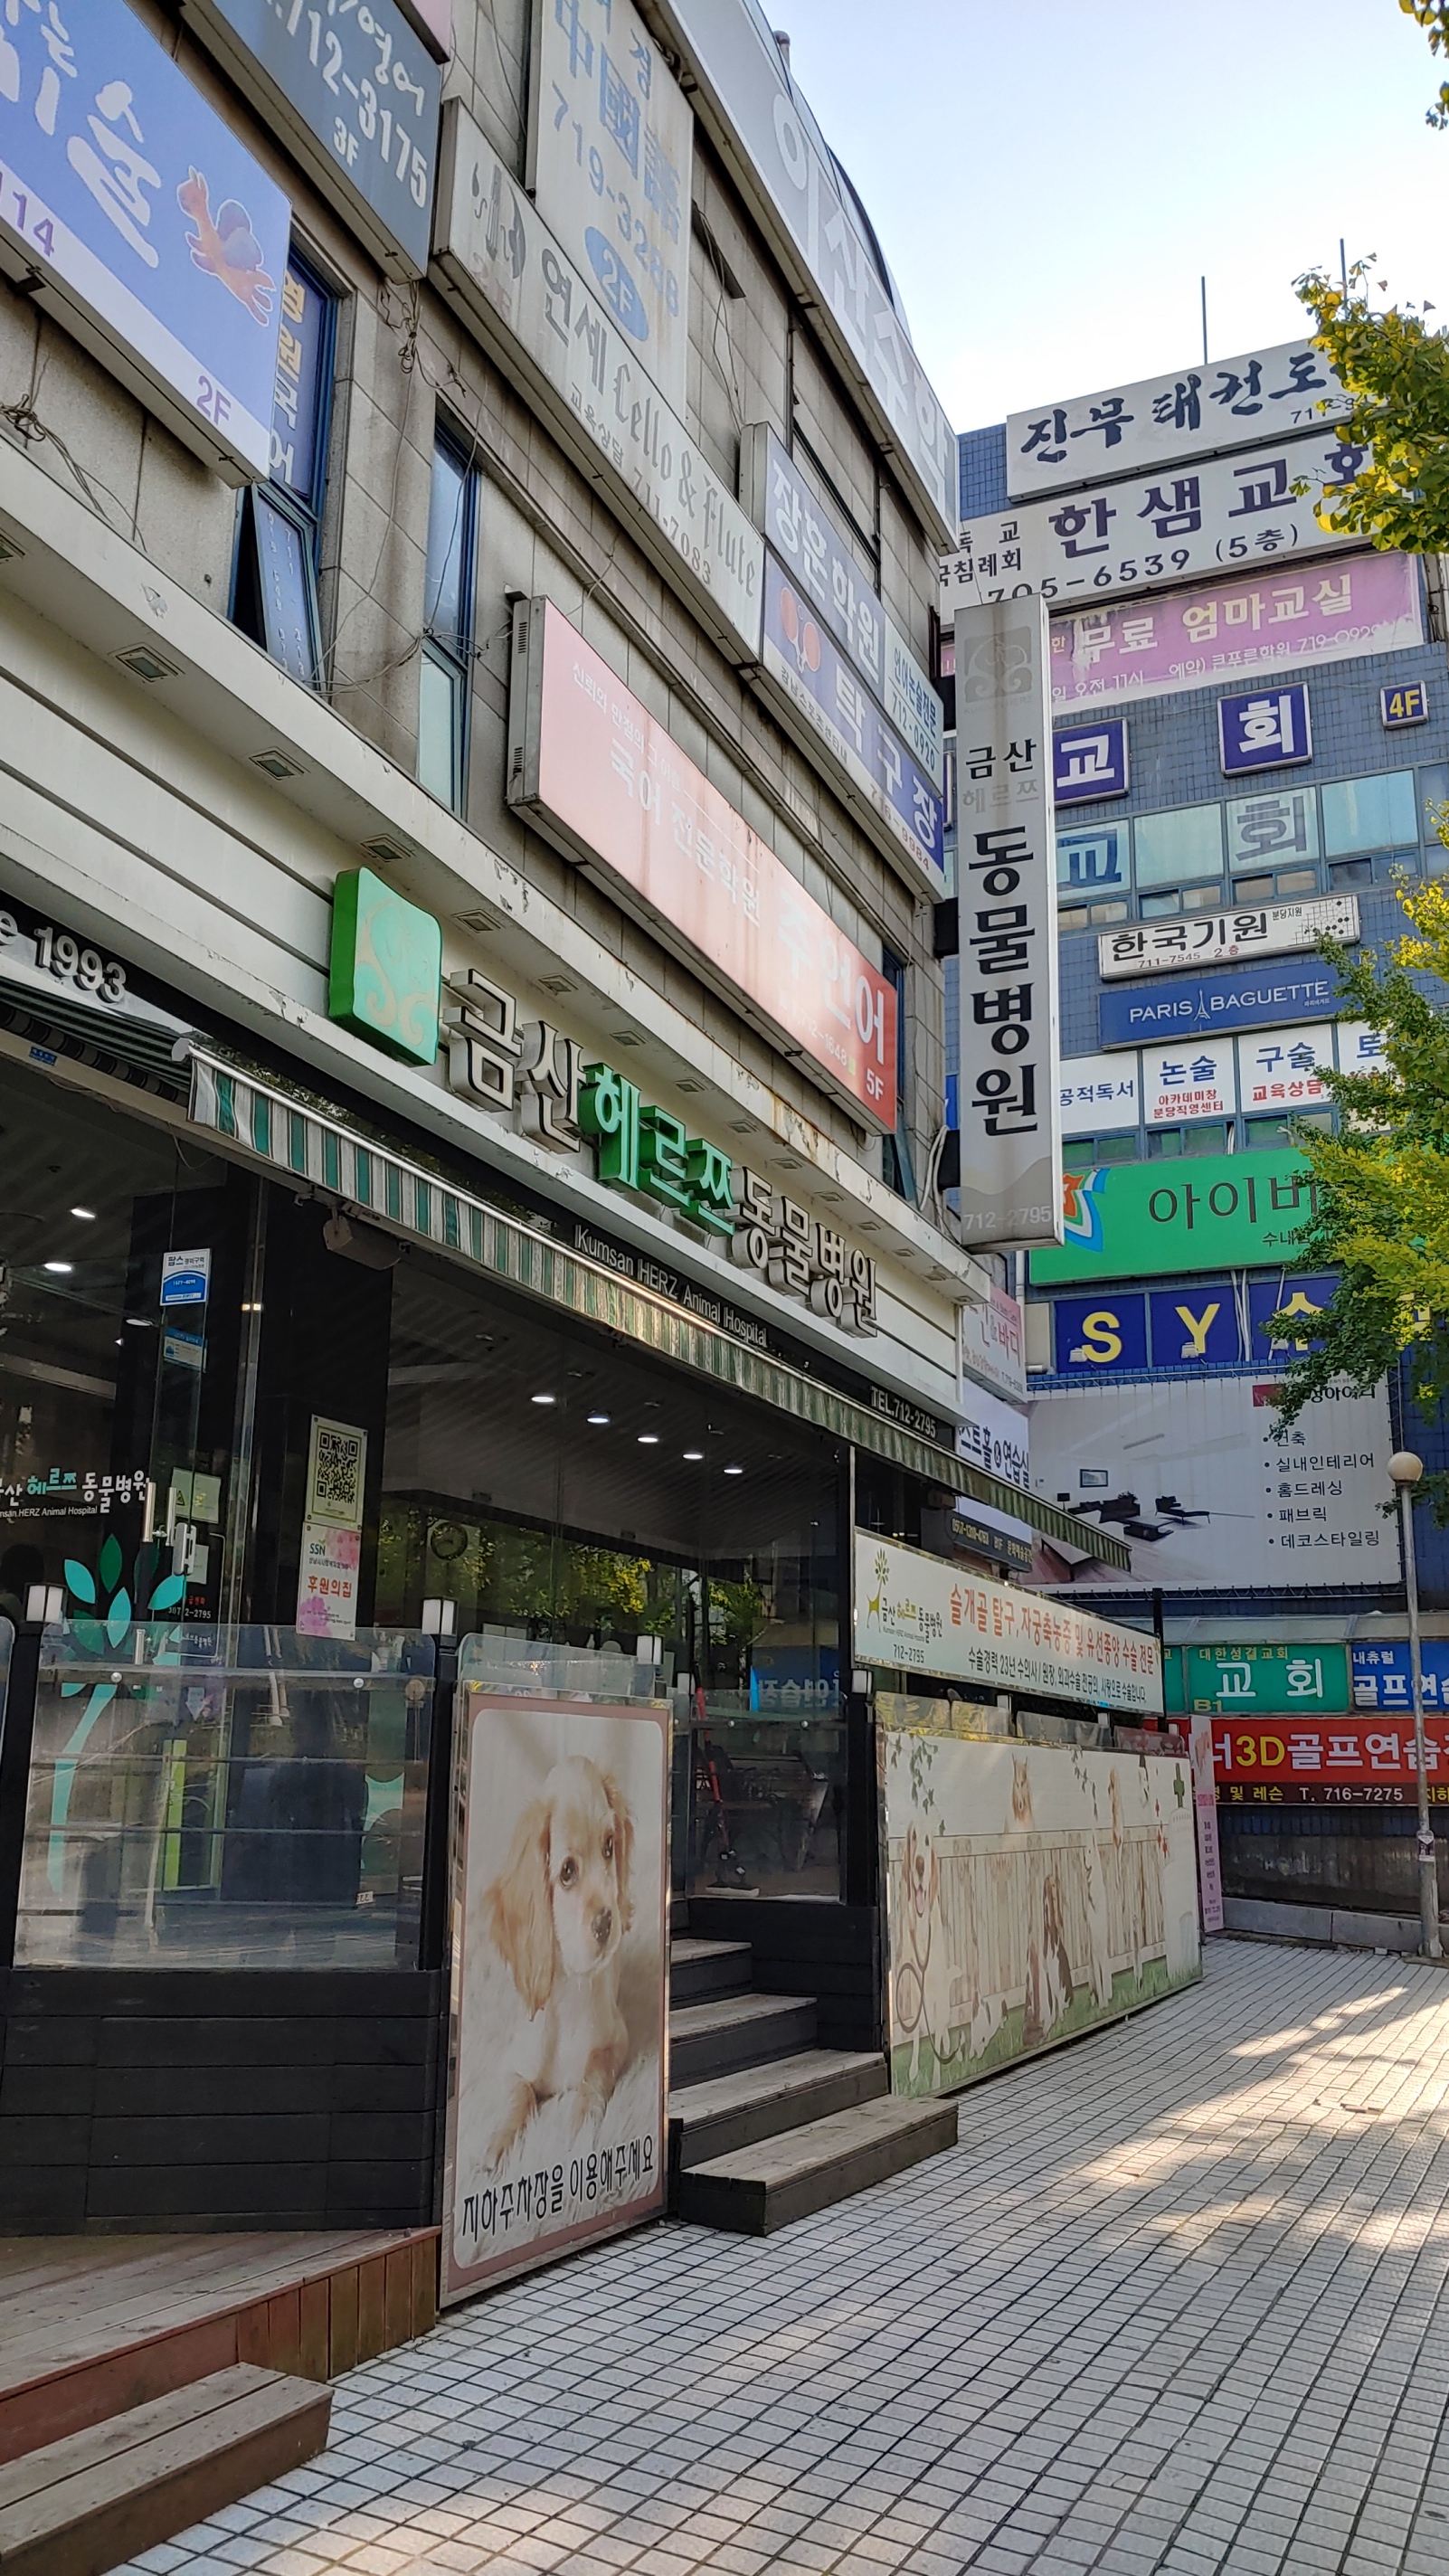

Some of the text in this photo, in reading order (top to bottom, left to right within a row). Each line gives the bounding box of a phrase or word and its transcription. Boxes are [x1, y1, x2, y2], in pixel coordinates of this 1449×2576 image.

[334, 117, 359, 167] 3F
[542, 248, 609, 351] 연세
[195, 375, 232, 426] 2F
[1020, 350, 1339, 464] 진무태권도
[1214, 522, 1300, 563] (5층)
[1181, 573, 1352, 644] 엄마교실
[1388, 688, 1421, 719] 4F
[891, 689, 937, 772] 712-0920
[965, 738, 1037, 780] 금산
[961, 778, 1040, 814] 헤르쯔
[609, 737, 662, 827] 국어
[670, 800, 761, 930] 전문학원
[1111, 912, 1268, 961] 한국기원
[33, 925, 128, 1005] 1993
[968, 824, 1039, 1137] 동물병원
[1137, 952, 1201, 969] 711-7545
[1129, 980, 1330, 1024] PARIS BAGUETTE
[1159, 1055, 1217, 1086] 논술
[1255, 1041, 1316, 1073] 구술
[865, 1066, 886, 1103] 5F
[1252, 1077, 1323, 1103] 교육상담
[443, 968, 583, 1154] 금산
[731, 1166, 878, 1340] 동물병원
[573, 1224, 768, 1349] Kumsan HERZ Animal Hospital
[1081, 1311, 1122, 1363] S
[1174, 1302, 1221, 1355] Y
[1275, 1452, 1375, 1473] 실내인테리어
[1276, 1480, 1343, 1498] 홈드레싱
[42, 1506, 67, 1517] Animal
[68, 1505, 98, 1517] Hospital
[1278, 1506, 1328, 1523] 패브릭
[308, 1542, 327, 1557] SSN
[1280, 1530, 1380, 1549] 데코스타일링
[950, 1583, 989, 1634] 슬개골
[1086, 1627, 1121, 1669] 유선종양
[893, 1643, 925, 1664] 712-2795
[968, 1645, 999, 1674] 수술경력
[1198, 1645, 1290, 1662] 대한성결교회
[1352, 1649, 1396, 1666] 내츄럴
[1193, 1699, 1223, 1712] B1
[1229, 1785, 1245, 1802] 및
[1252, 1785, 1284, 1802] 레슨
[1323, 1786, 1404, 1802] 716-7275
[461, 2164, 564, 2243] 지하주차장을
